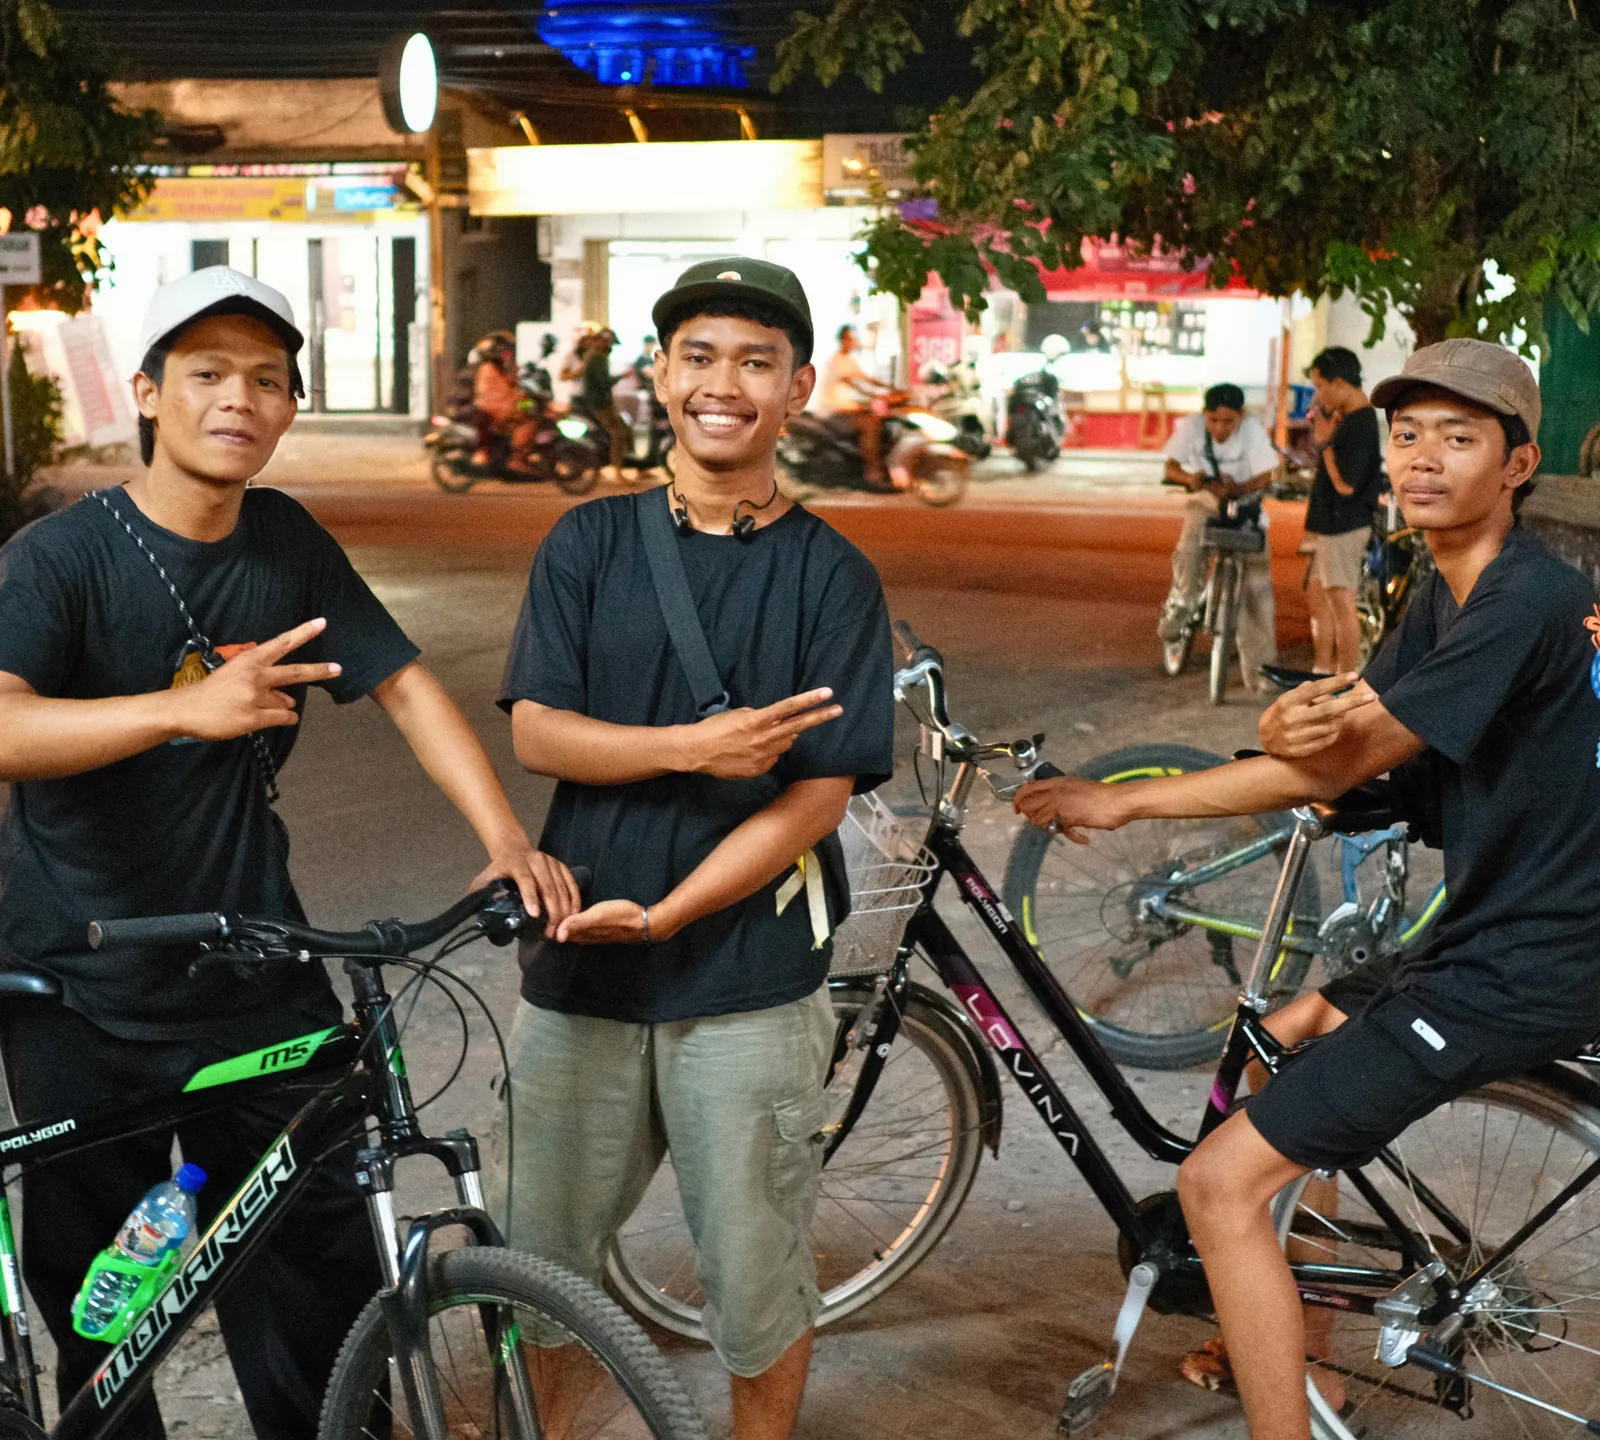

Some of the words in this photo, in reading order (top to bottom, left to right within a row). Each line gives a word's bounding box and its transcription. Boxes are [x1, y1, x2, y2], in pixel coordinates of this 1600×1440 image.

[914, 336, 957, 365] 3GB
[966, 877, 1008, 934] POLYGON
[260, 1040, 310, 1070] M5
[966, 993, 1079, 1157] LOVINA
[0, 1118, 76, 1152] POLYGON
[93, 1134, 297, 1409] MONARCH
